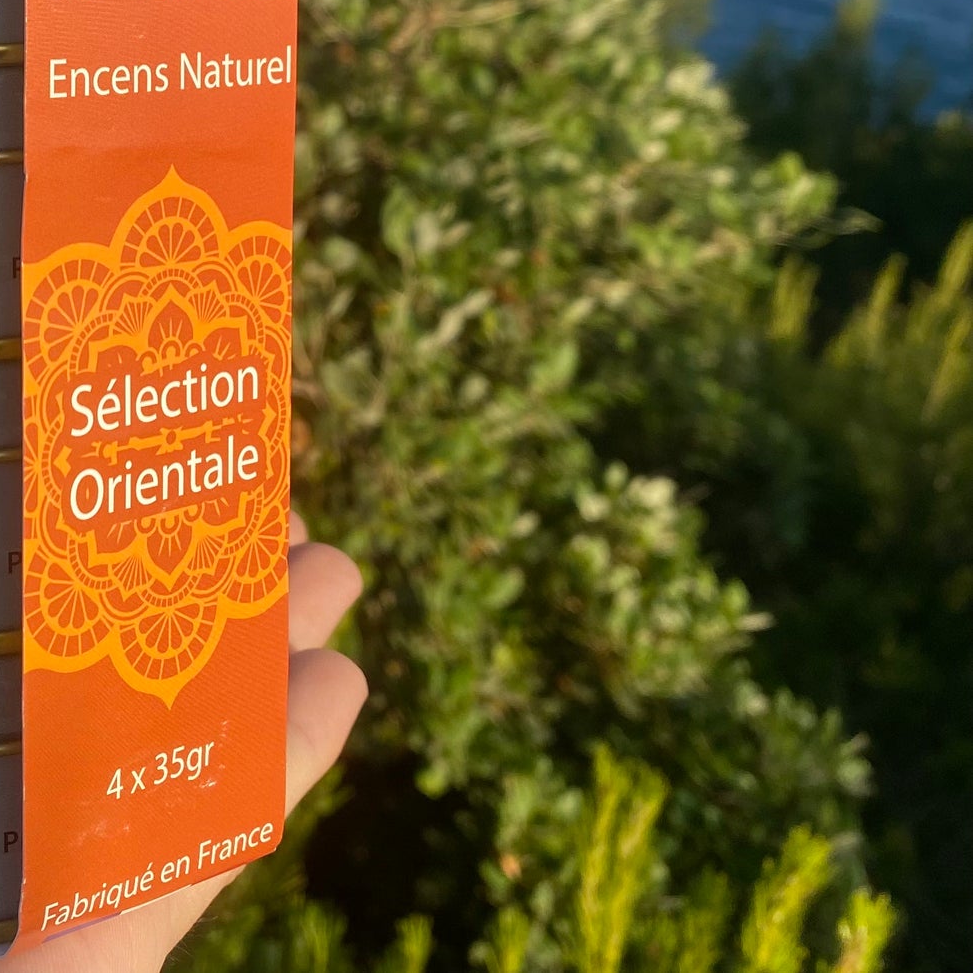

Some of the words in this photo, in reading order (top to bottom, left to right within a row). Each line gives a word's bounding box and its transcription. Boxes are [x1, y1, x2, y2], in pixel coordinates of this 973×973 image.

[49, 58, 169, 99] Encens
[179, 45, 292, 91] Naturel
[69, 363, 259, 437] Sélection
[69, 435, 259, 521] Orientale
[106, 768, 124, 800] 4
[130, 766, 146, 794] x
[153, 741, 215, 785] 35gr
[41, 862, 154, 931] Fabriqué
[160, 854, 190, 883] en
[197, 822, 273, 869] France
